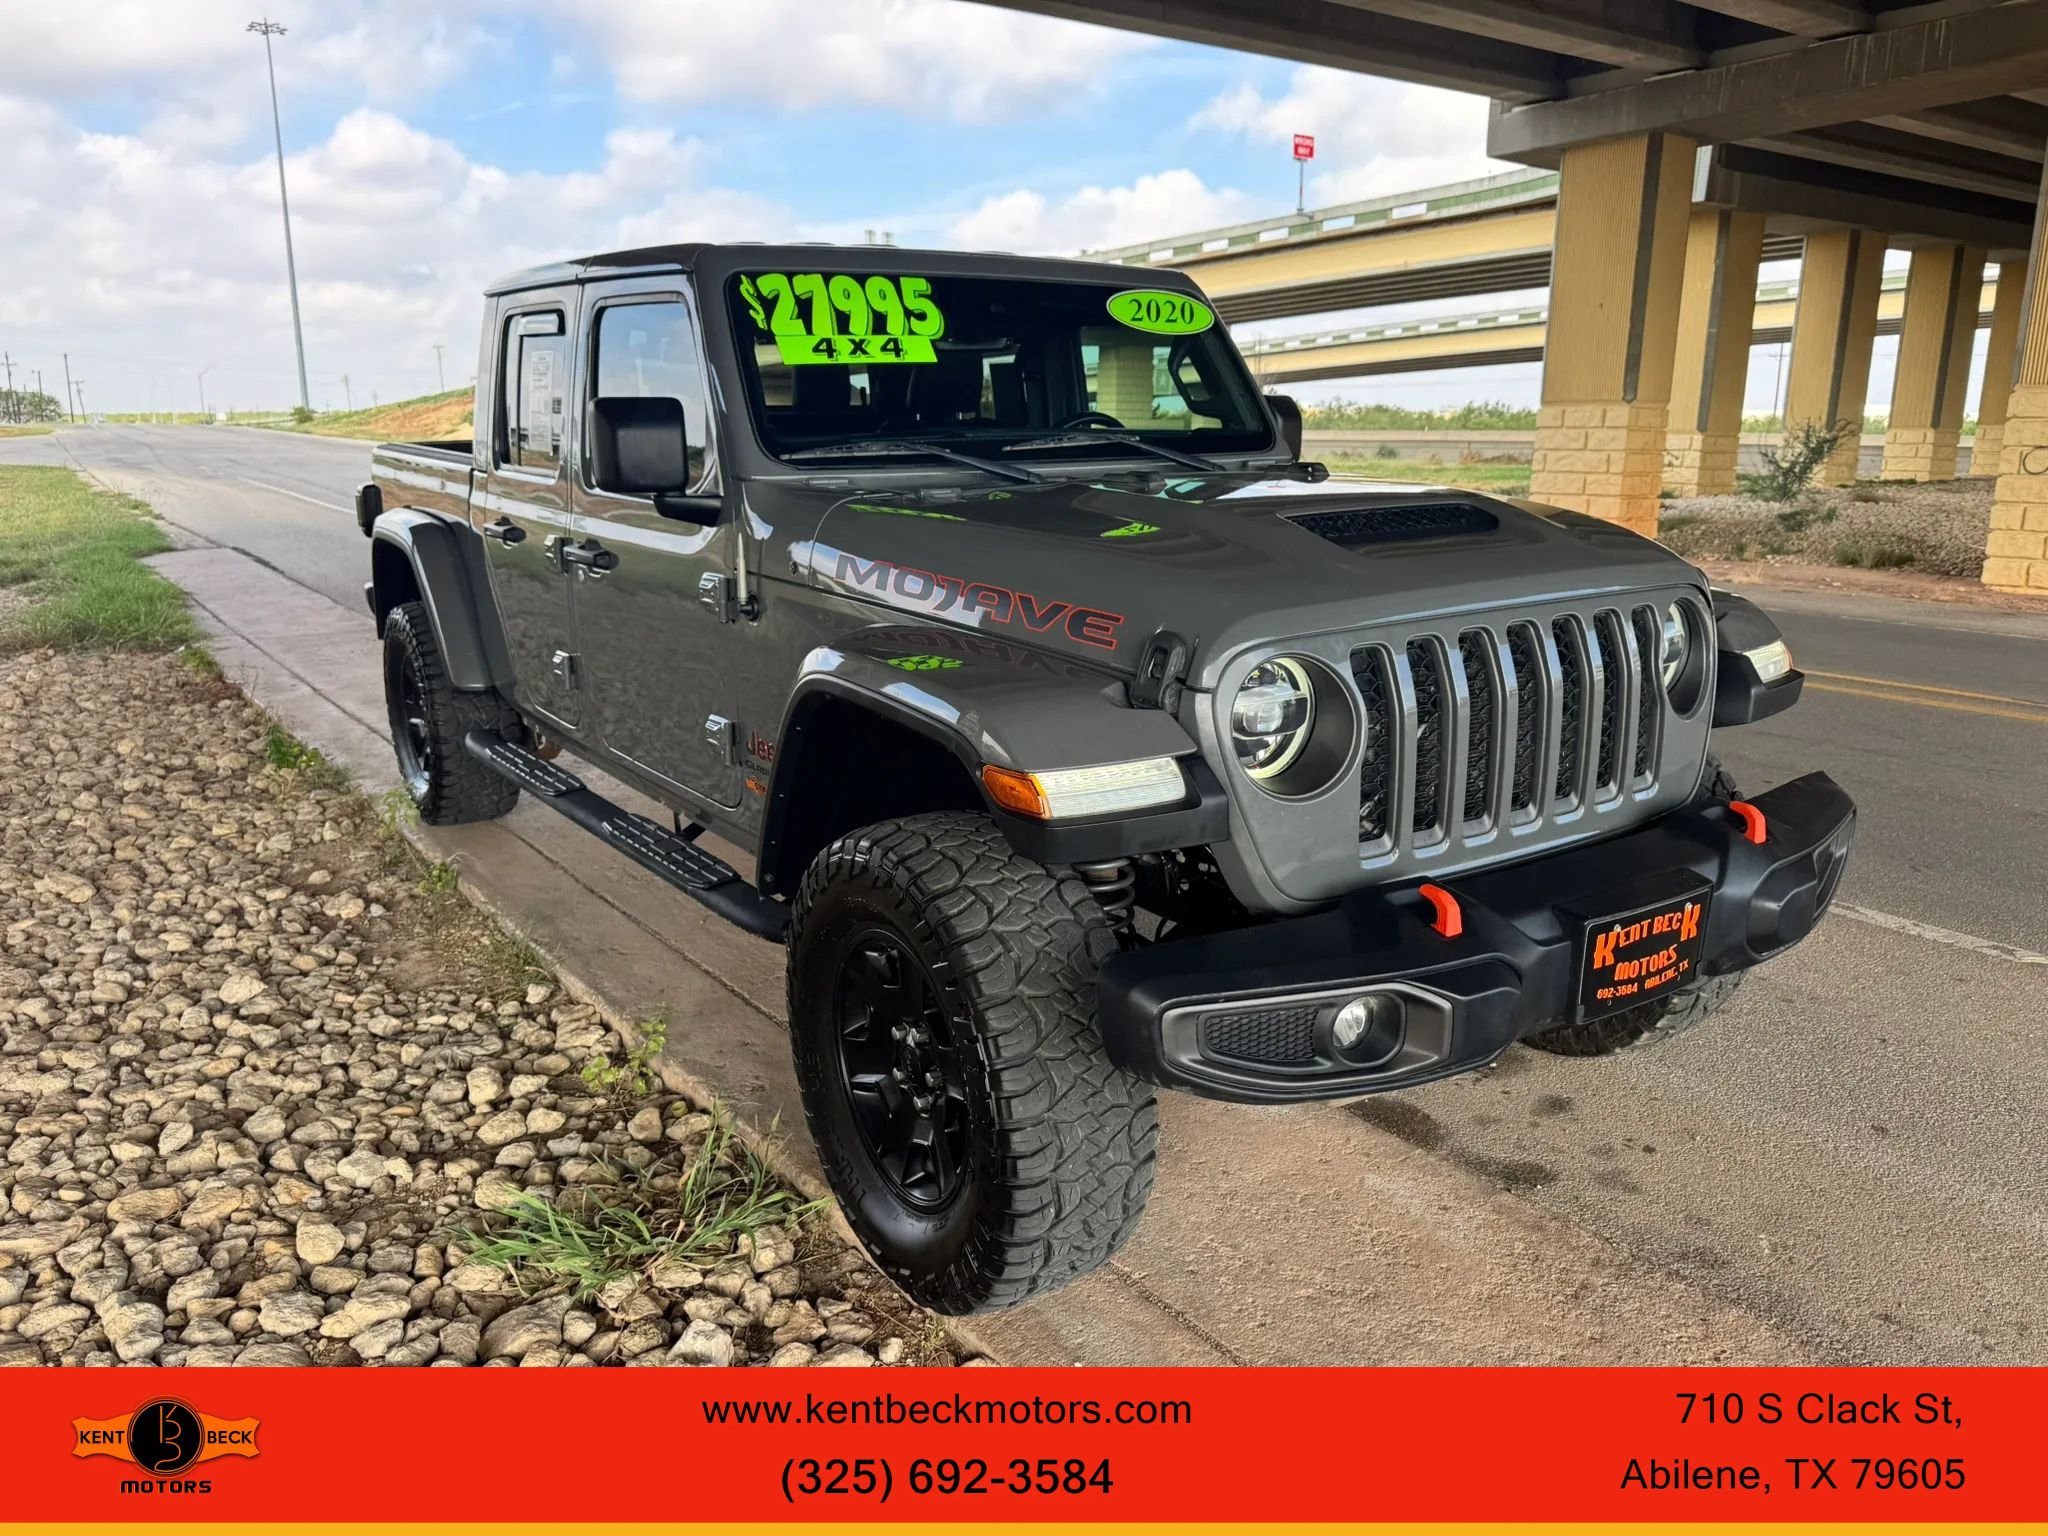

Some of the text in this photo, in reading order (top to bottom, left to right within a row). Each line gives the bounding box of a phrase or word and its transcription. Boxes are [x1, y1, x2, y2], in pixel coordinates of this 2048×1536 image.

[739, 272, 945, 340] $27995
[1128, 298, 1195, 325] 2020
[833, 553, 1124, 651] MOJAVE
[1596, 982, 1638, 1000] 692-3584
[1679, 958, 1689, 972] TX
[1614, 943, 1678, 981] MOTORS
